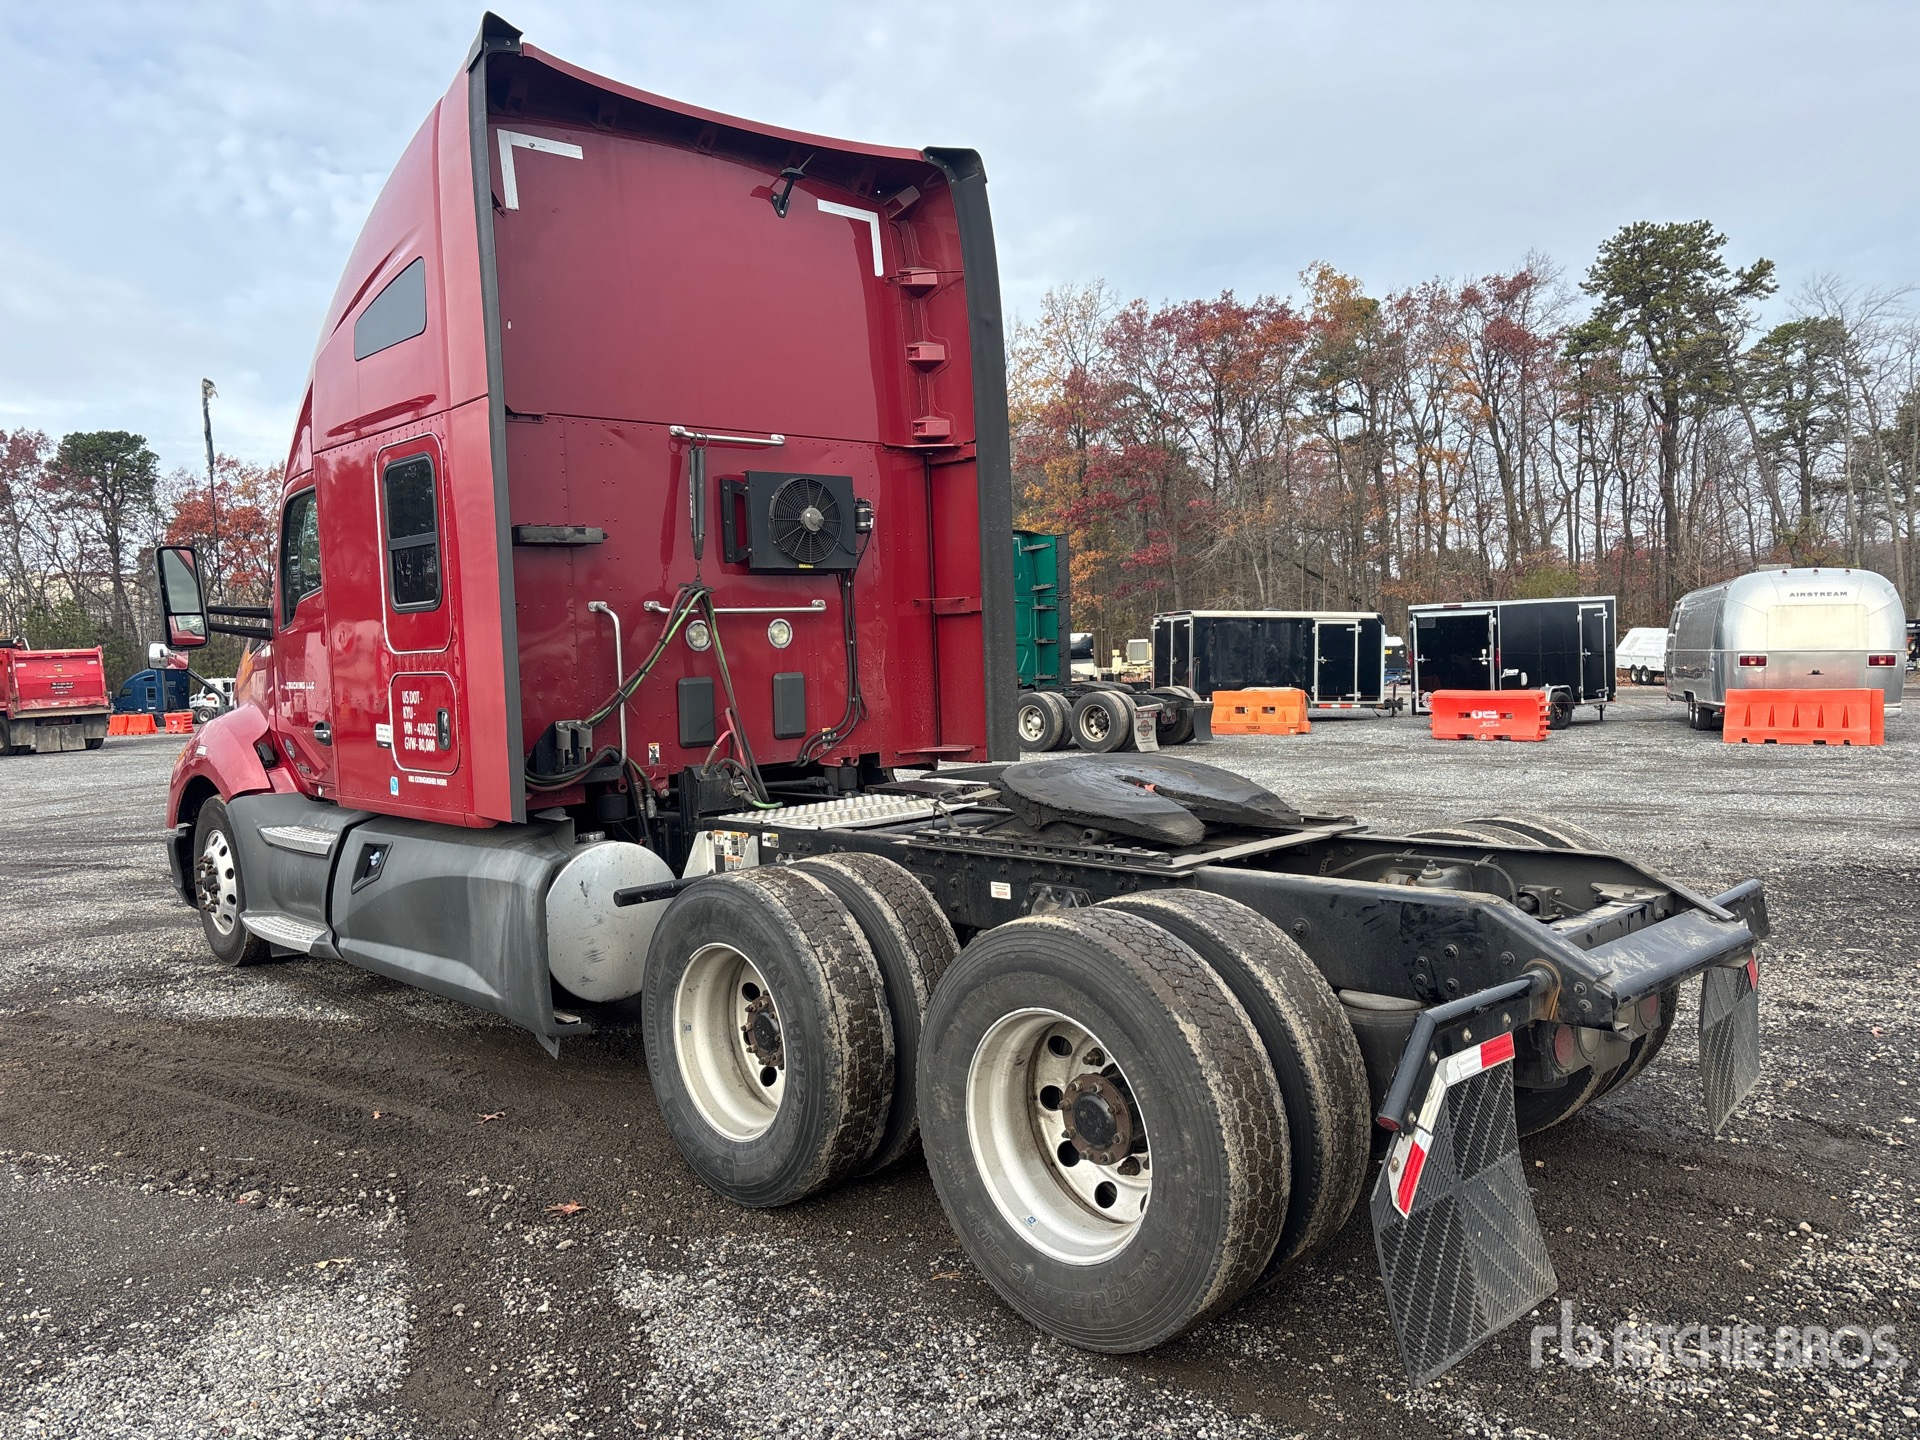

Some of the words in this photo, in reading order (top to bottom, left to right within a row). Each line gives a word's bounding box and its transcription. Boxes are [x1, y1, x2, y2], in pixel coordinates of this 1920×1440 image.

[306, 681, 315, 689] LLC
[402, 690, 409, 704] US
[409, 690, 420, 704] DOT
[403, 721, 413, 734] VIN
[418, 737, 435, 753] 80,000
[645, 974, 662, 1078] Continental
[967, 1216, 1030, 1285] COIN
[1033, 1269, 1146, 1311] DOUBLE
